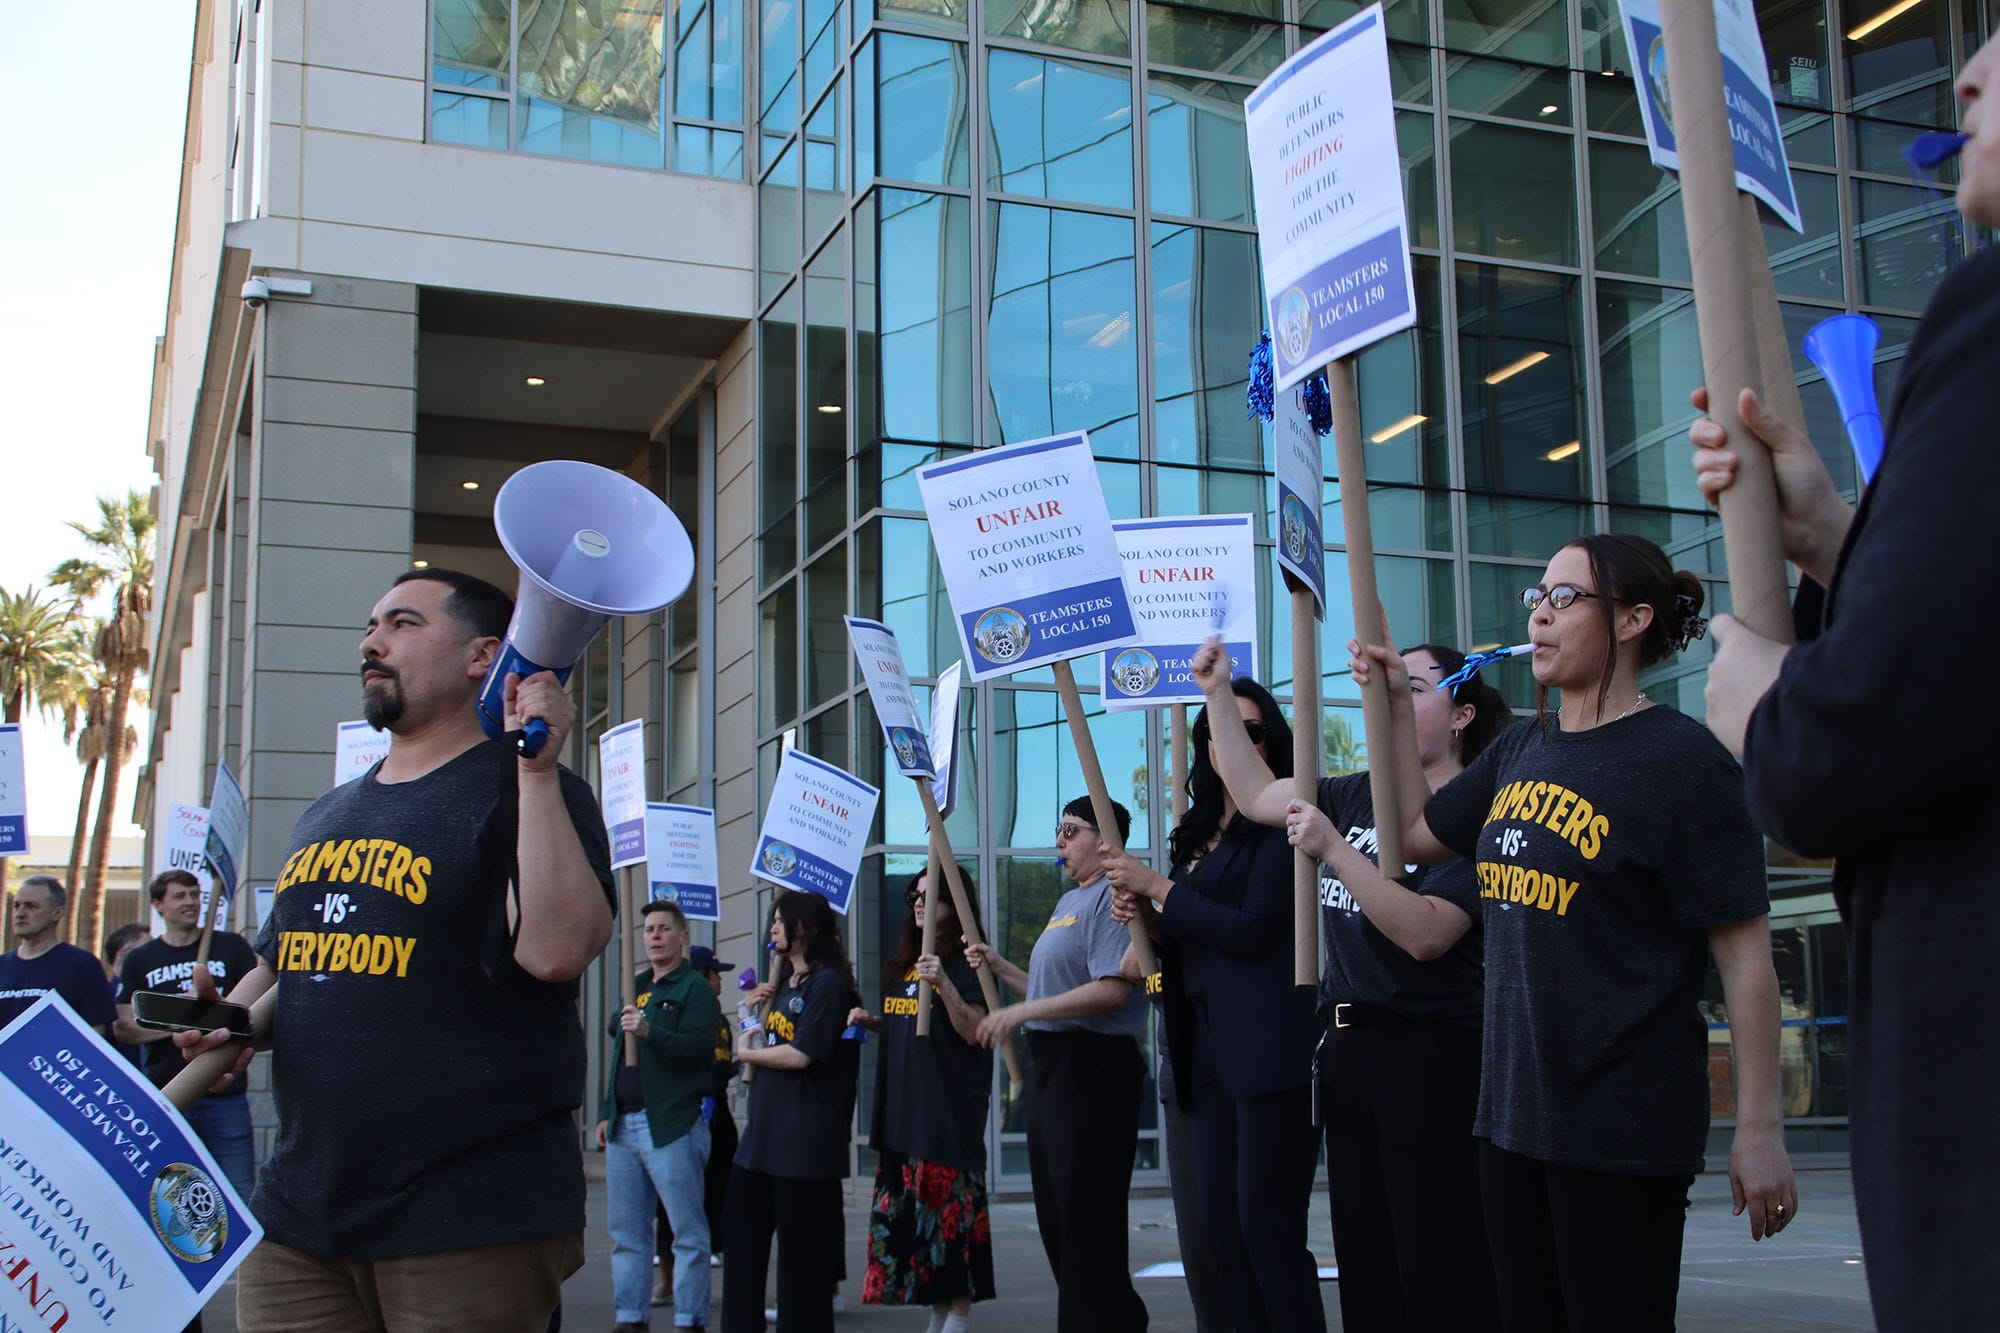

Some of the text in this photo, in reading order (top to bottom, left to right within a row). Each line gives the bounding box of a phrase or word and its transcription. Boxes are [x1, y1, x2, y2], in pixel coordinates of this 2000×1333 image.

[1790, 57, 1817, 69] SEIU
[1285, 89, 1327, 129] PUBLIC
[1278, 106, 1345, 162] DEFENDERS
[1284, 134, 1344, 187] FIGHTING
[1291, 169, 1340, 211] FOR THE
[1285, 189, 1356, 244] COMMUNITY
[1311, 256, 1389, 309] TEAMSTERS
[1318, 283, 1385, 330] LOCAL 150
[948, 473, 1071, 512] SOLANO COUNTY
[976, 499, 1064, 534] UNFAIR
[967, 524, 1083, 562] TO COMMUNITY
[978, 543, 1086, 580] AND WORKERS
[1119, 545, 1231, 562] SOLANO COUNTY
[1138, 566, 1216, 585] UNFAIR
[1029, 595, 1114, 626] TEAMSTERS
[1131, 591, 1230, 605] O COMMUNITY
[1137, 607, 1227, 621] ND WORKERS
[1040, 613, 1112, 641] LOCAL 150
[793, 771, 863, 809] SOLANO COUNTY
[802, 790, 850, 821] UNFAIR
[787, 816, 848, 848] AND WORKERS
[789, 803, 854, 838] TO COMMUNITY
[1483, 780, 1610, 860] EAMSTERS
[169, 848, 210, 873] UNFA
[669, 840, 700, 849] FIGHTING
[274, 838, 433, 906] EAMSTERS
[798, 859, 844, 887] TEAMSTERS
[799, 870, 838, 895] LOCAL 150
[1476, 861, 1581, 917] ERYBODY
[680, 890, 712, 900] TEAMSTERS
[682, 899, 701, 908] LOCAL
[278, 931, 417, 978] VERYBODY
[145, 960, 227, 989] TEAMSTRS
[883, 996, 919, 1016] EVERYBO
[28, 1054, 153, 1178] TEAMSTERS
[55, 1048, 163, 1152] LOCAL 150
[0, 1136, 135, 1292] AND WORKER
[0, 1176, 90, 1285] COMMUN
[0, 1230, 70, 1333] UNF
[88, 1286, 119, 1327] TO
